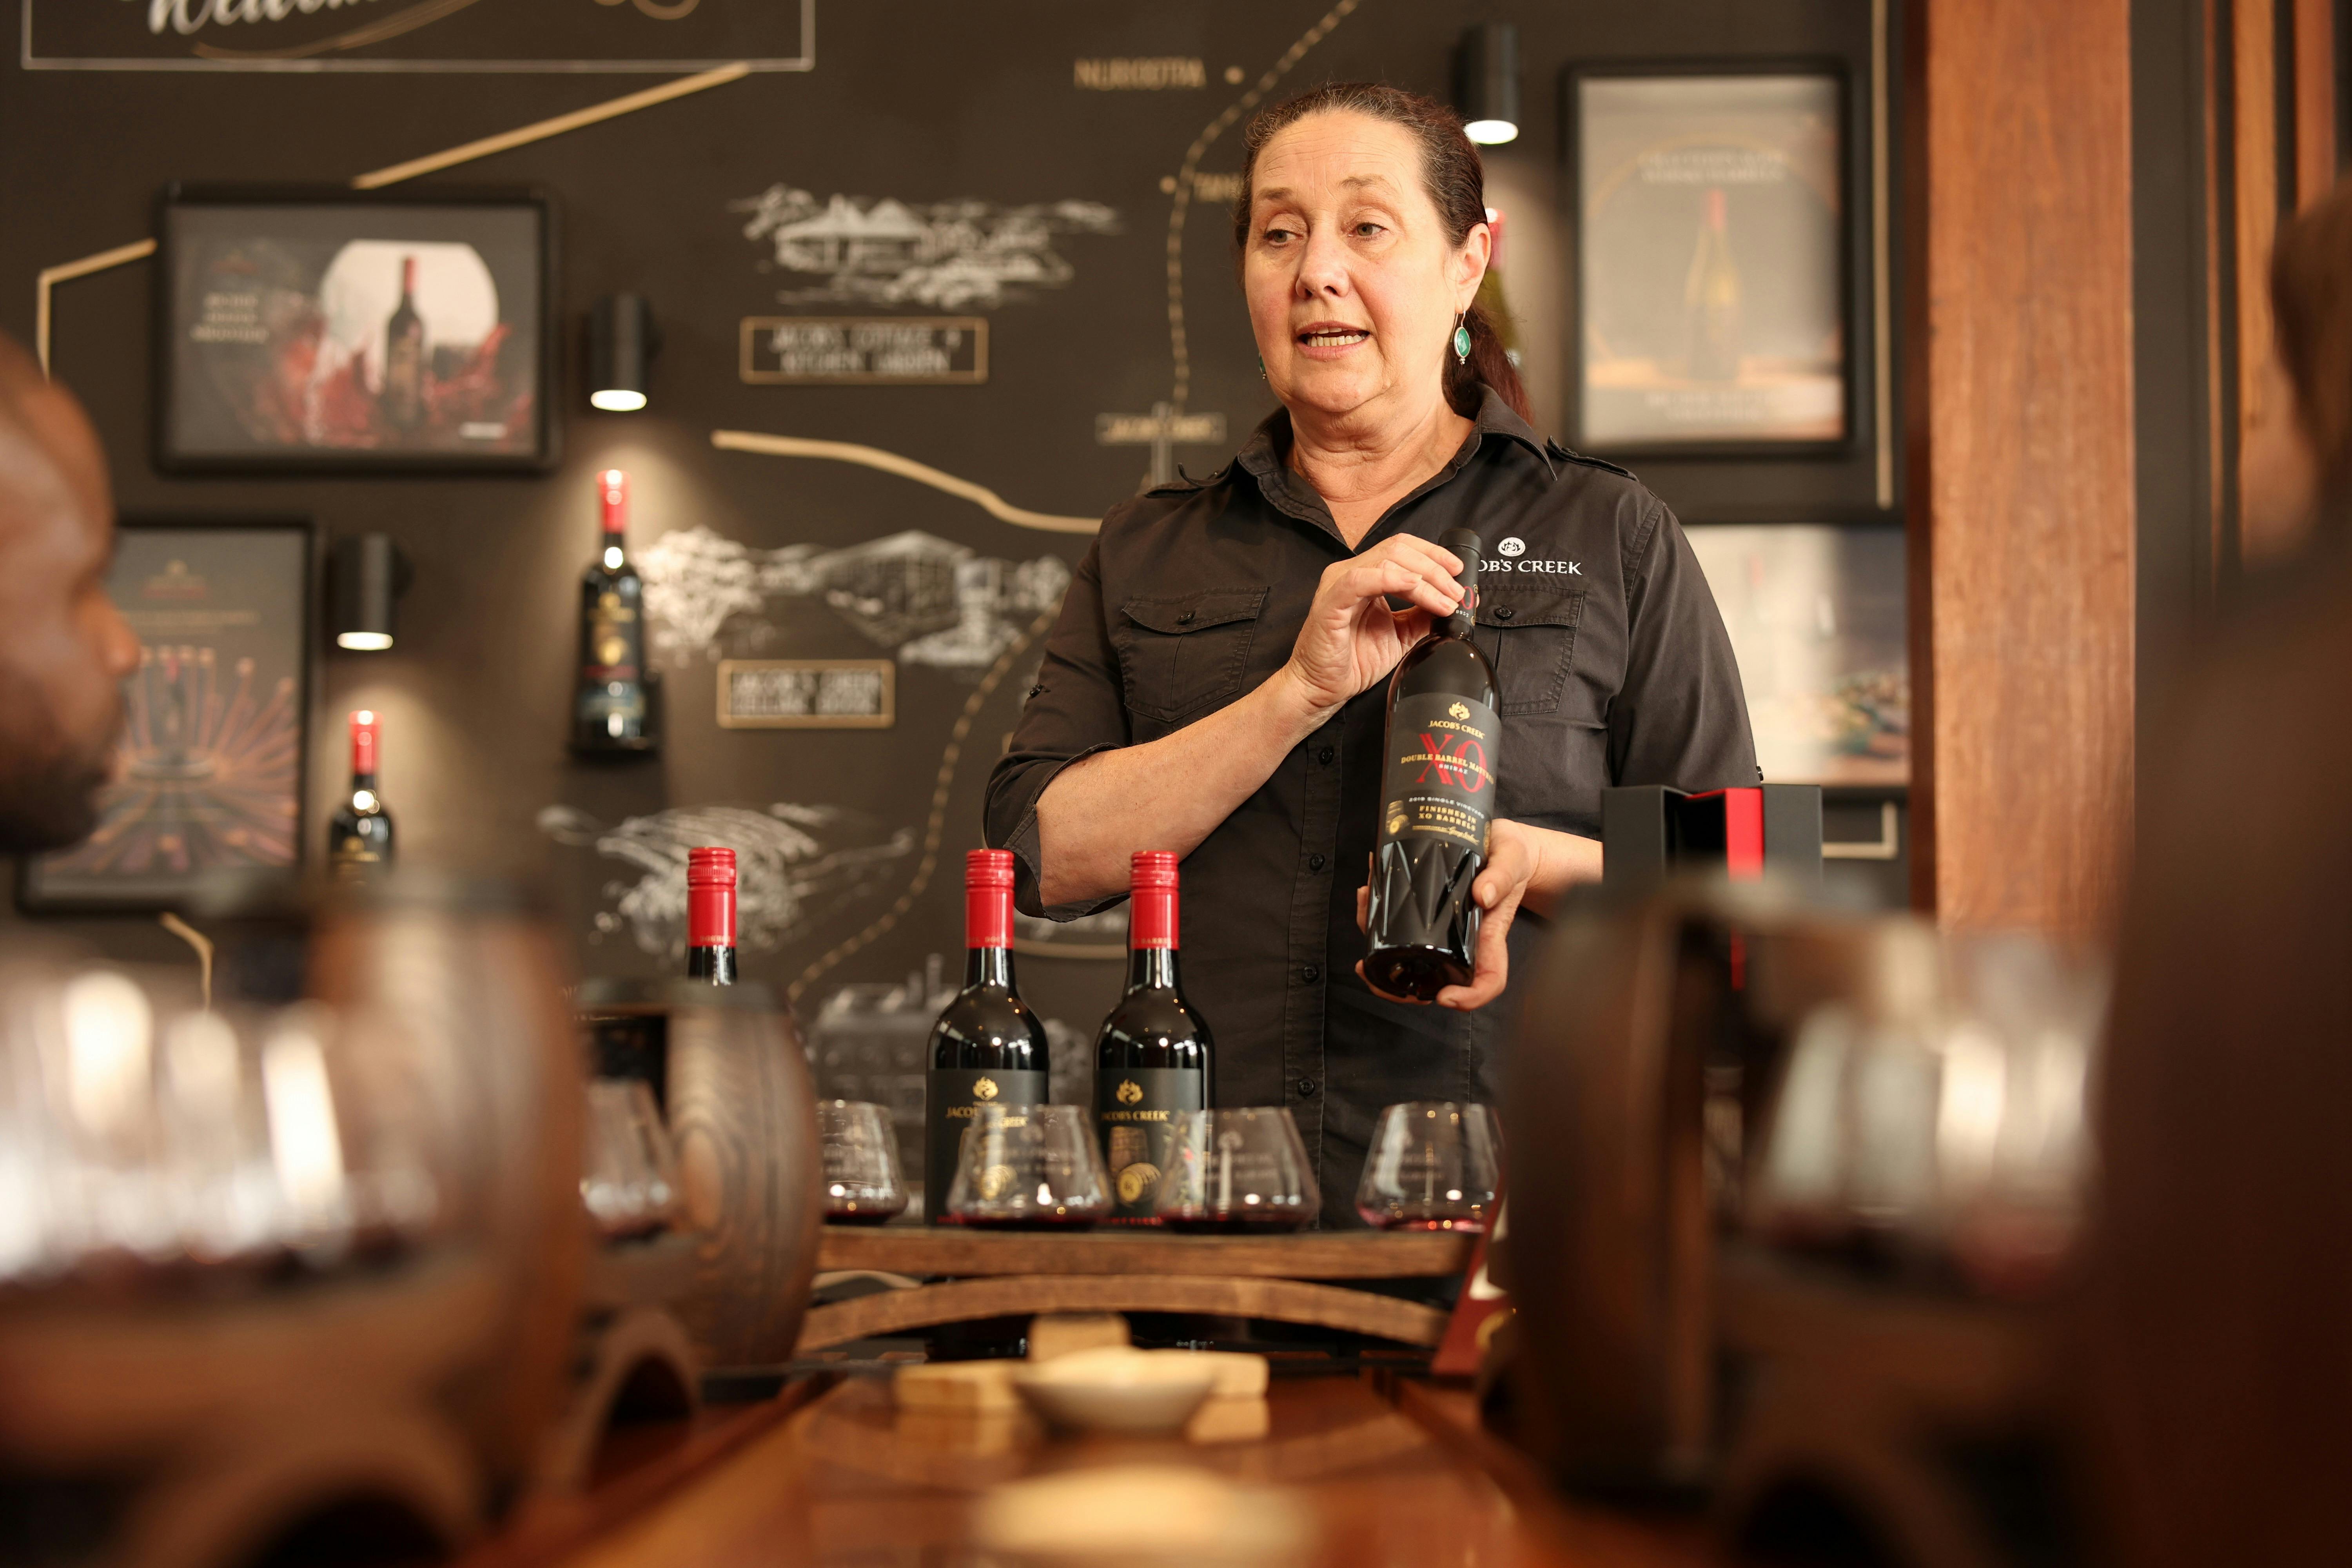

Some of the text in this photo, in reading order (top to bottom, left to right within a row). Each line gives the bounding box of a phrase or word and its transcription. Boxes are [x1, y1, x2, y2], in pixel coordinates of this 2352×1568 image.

[1478, 559, 1583, 575] OB'S CREEK
[1428, 720, 1486, 740] JACOB'S CREEK
[1401, 753, 1434, 764] DOUBLE
[1434, 754, 1468, 767] BARREL
[1416, 733, 1487, 793] XO
[1438, 763, 1468, 775] SHIRAZ
[1427, 796, 1455, 805] SINGLE
[1419, 805, 1477, 824] FINISHED IN
[1436, 813, 1476, 832] BARRELS
[1101, 1110, 1171, 1122] ACOB'S CREEK
